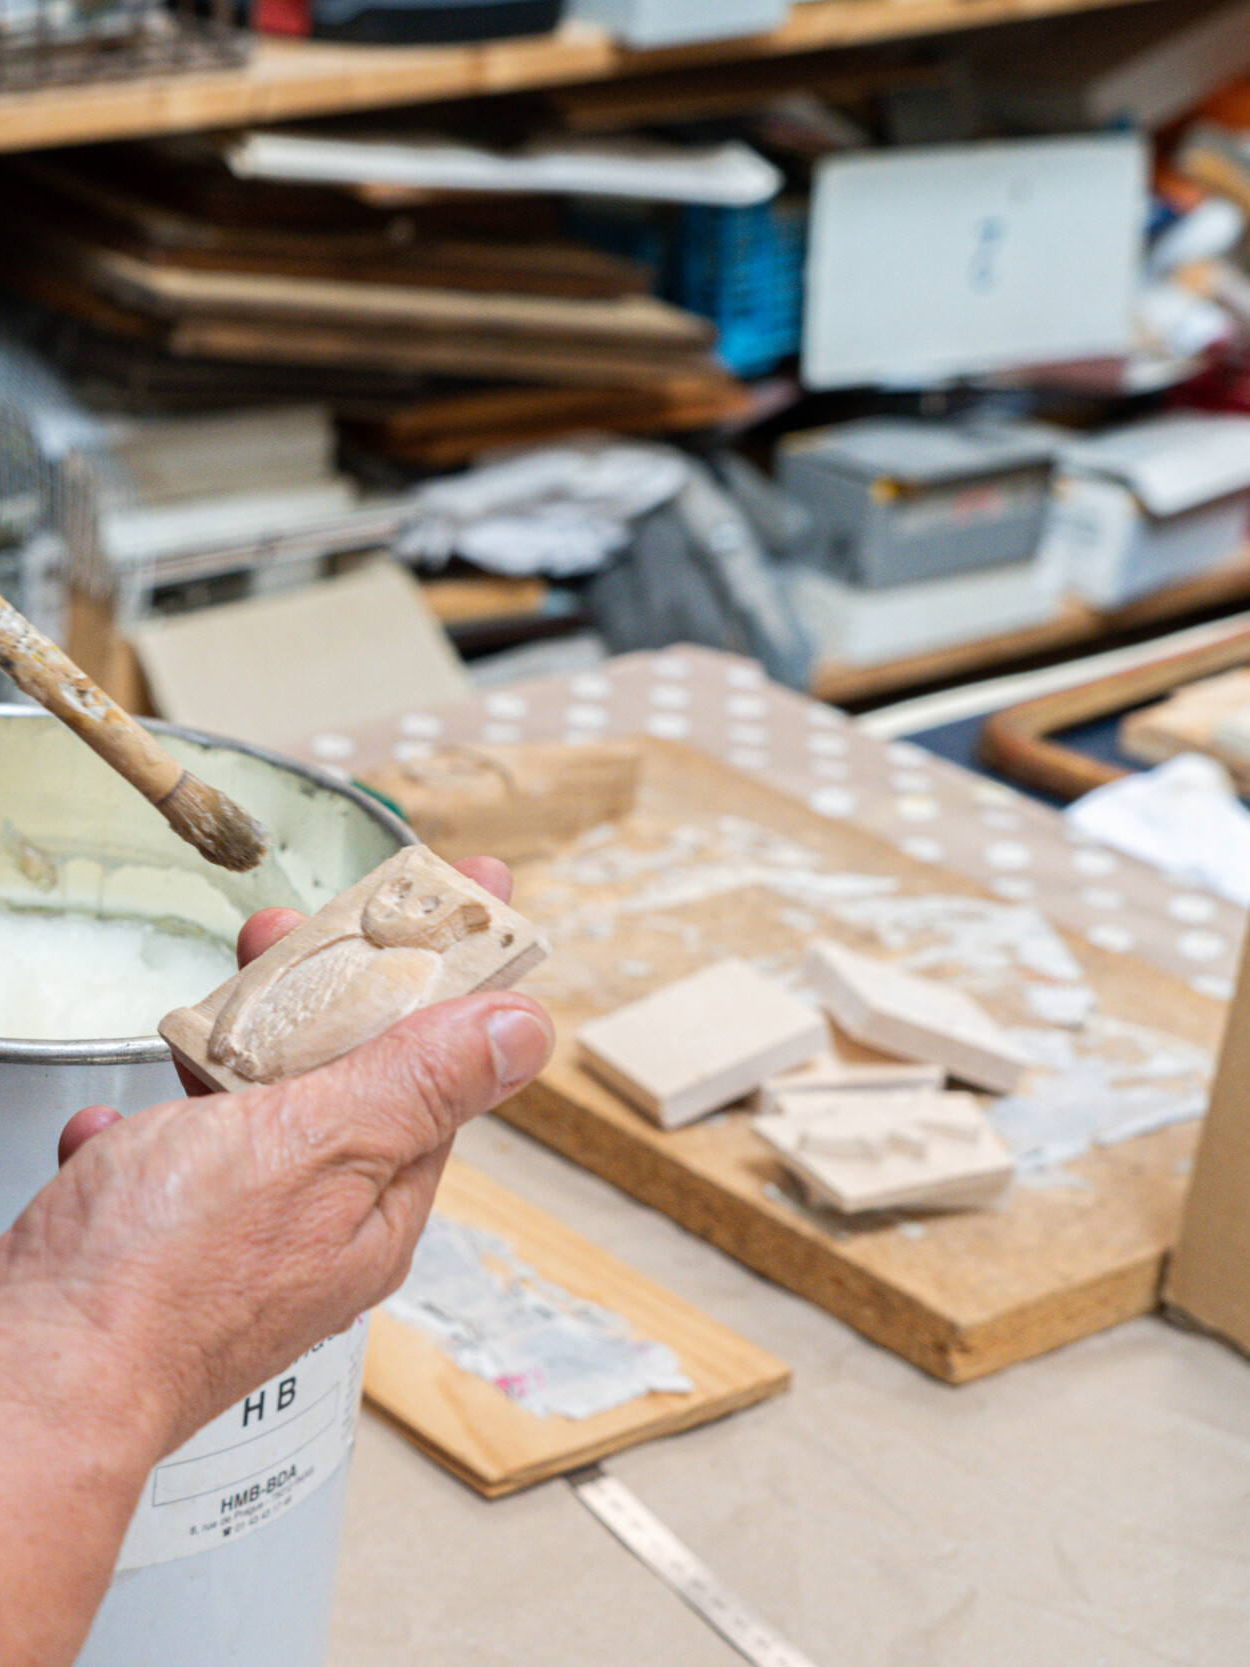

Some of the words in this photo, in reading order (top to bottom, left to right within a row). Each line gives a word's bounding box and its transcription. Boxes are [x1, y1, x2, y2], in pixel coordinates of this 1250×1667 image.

[242, 1390, 265, 1427] H
[276, 1376, 296, 1412] B
[220, 1464, 296, 1514] HMB-BDA
